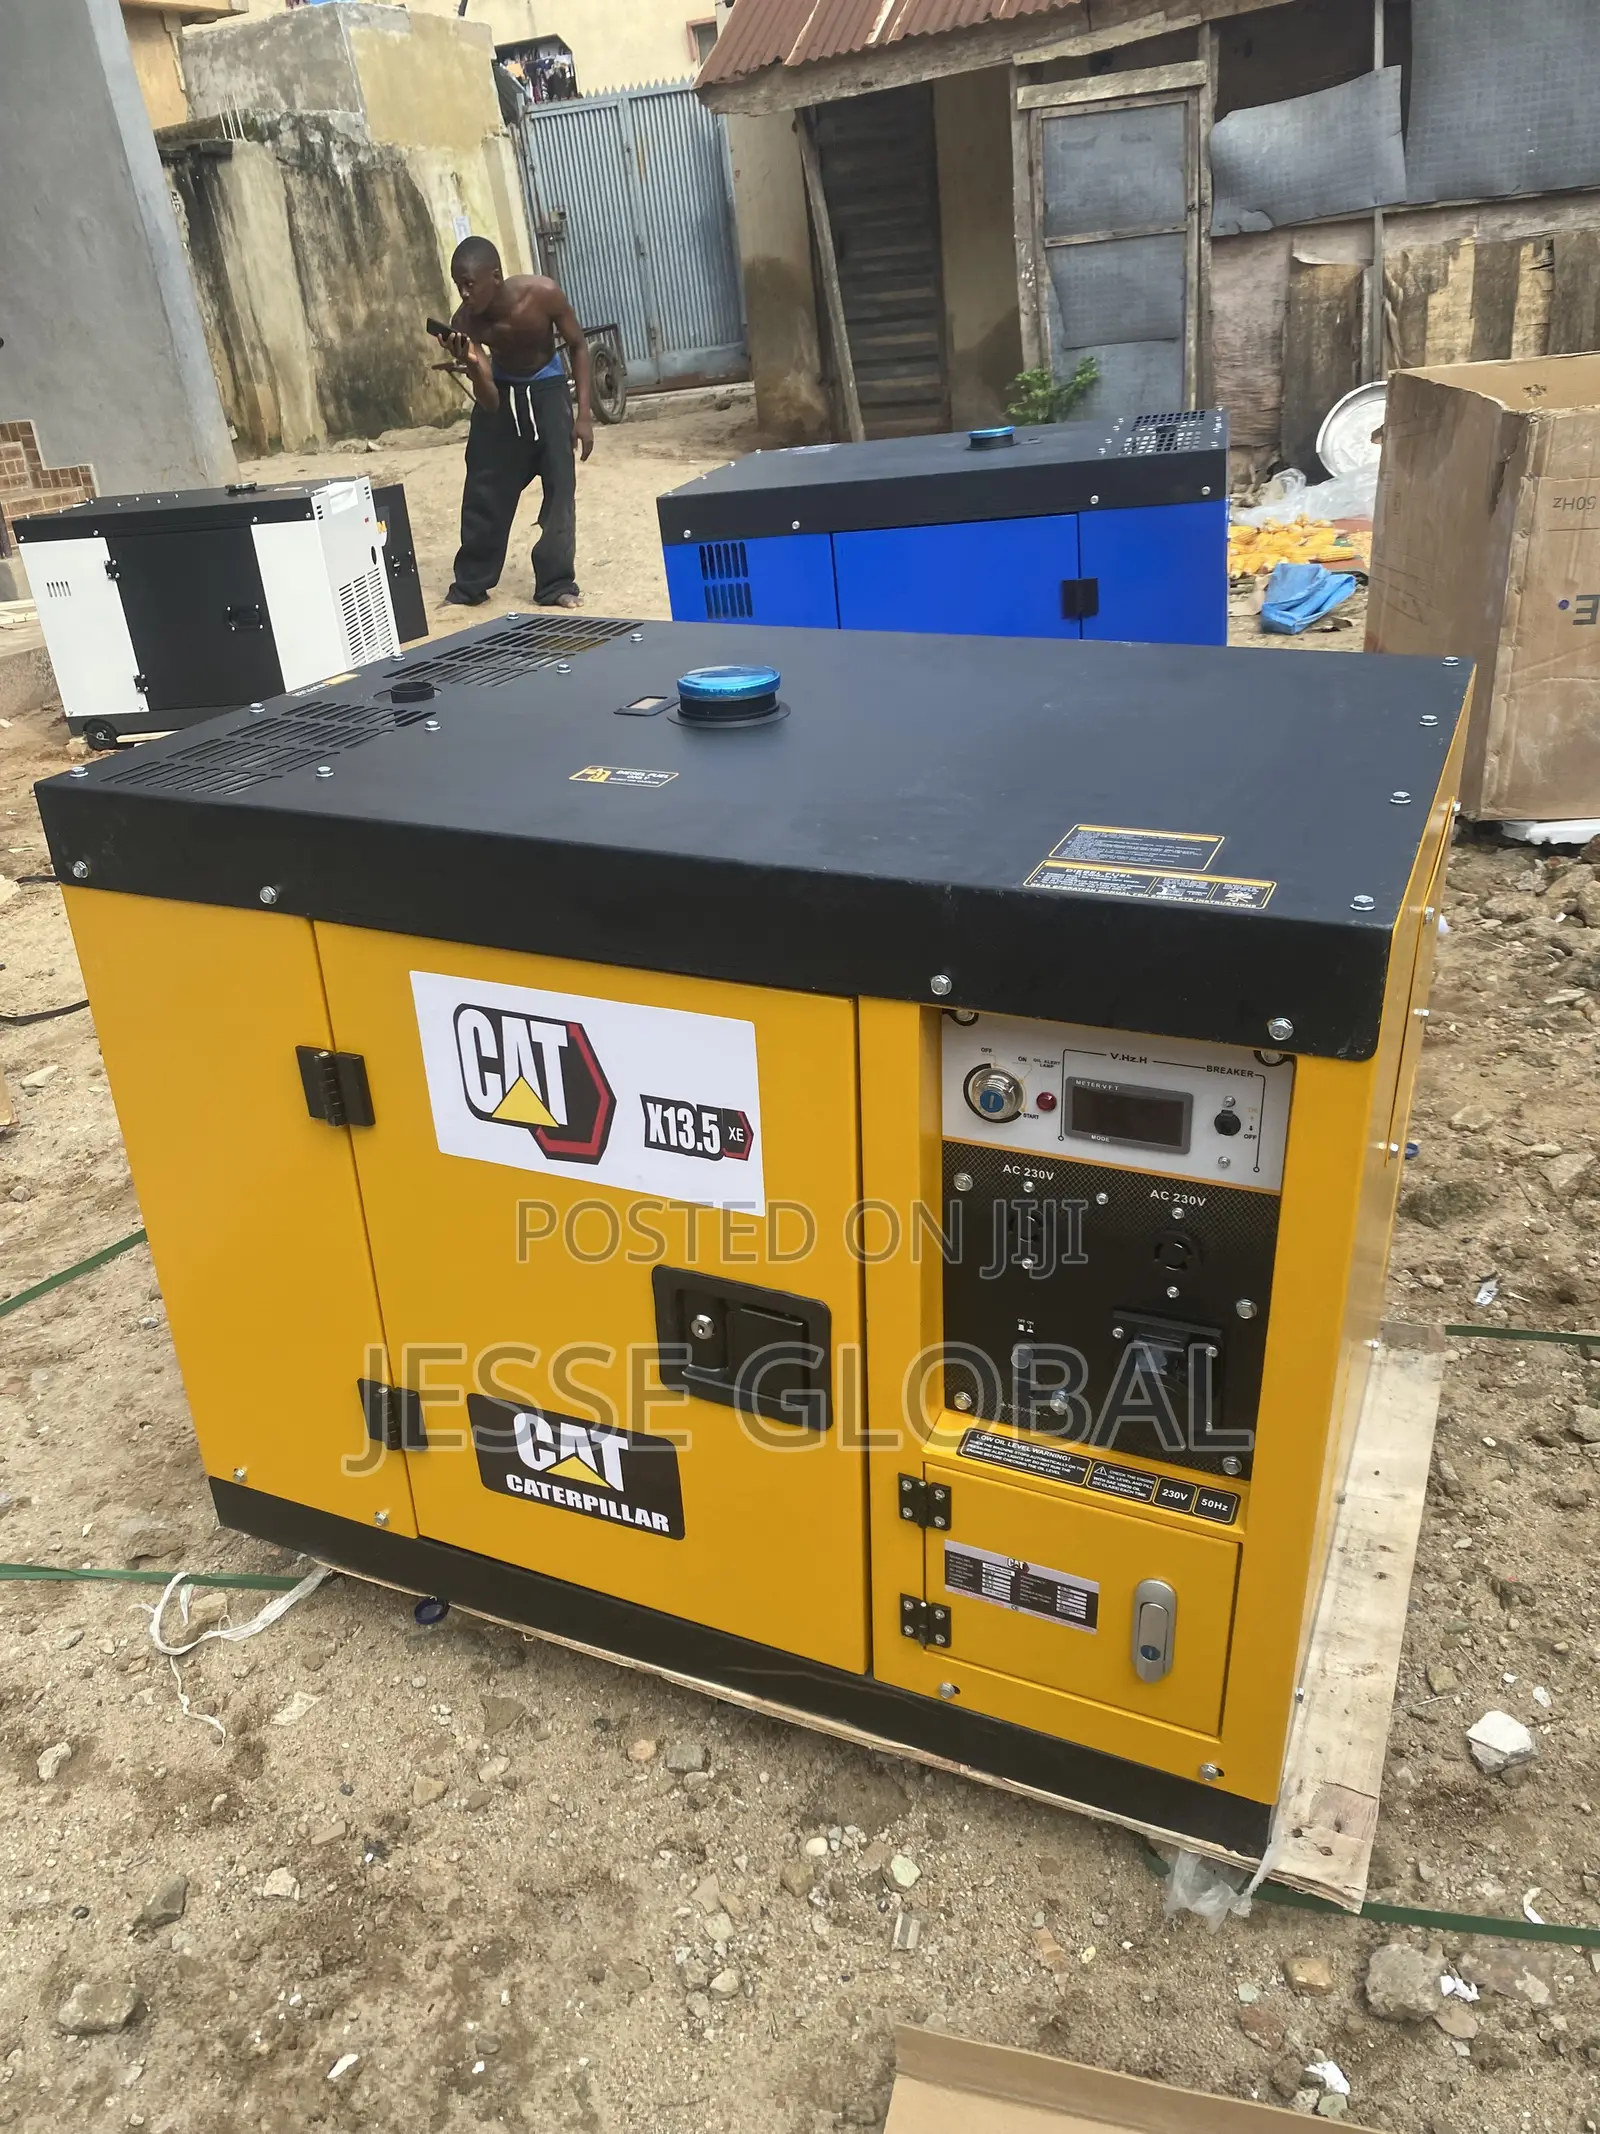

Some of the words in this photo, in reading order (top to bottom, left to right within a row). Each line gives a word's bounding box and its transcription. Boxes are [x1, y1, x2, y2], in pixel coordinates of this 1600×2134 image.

[1110, 1052, 1148, 1064] V.Hz.H
[1206, 1065, 1254, 1077] BREAKER
[457, 1008, 569, 1127] CAT
[646, 1102, 722, 1154] X13.5
[728, 1126, 745, 1142] XE
[1023, 1112, 1039, 1120] START
[1091, 1134, 1110, 1142] MODE
[1003, 1164, 1020, 1175] AC
[1023, 1168, 1055, 1181] 230V
[1150, 1189, 1170, 1201] AC
[1173, 1193, 1207, 1207] 230V
[513, 1412, 629, 1492] CAT
[976, 1433, 995, 1443] LOW
[994, 1438, 1007, 1446] OIL
[1007, 1441, 1031, 1452] LEVEL
[1032, 1447, 1072, 1462] WARNING!
[1161, 1488, 1188, 1501] 230V
[505, 1473, 670, 1533] CATERPILLAR
[1200, 1498, 1229, 1512] 50Hz
[1008, 1557, 1024, 1570] CAT
